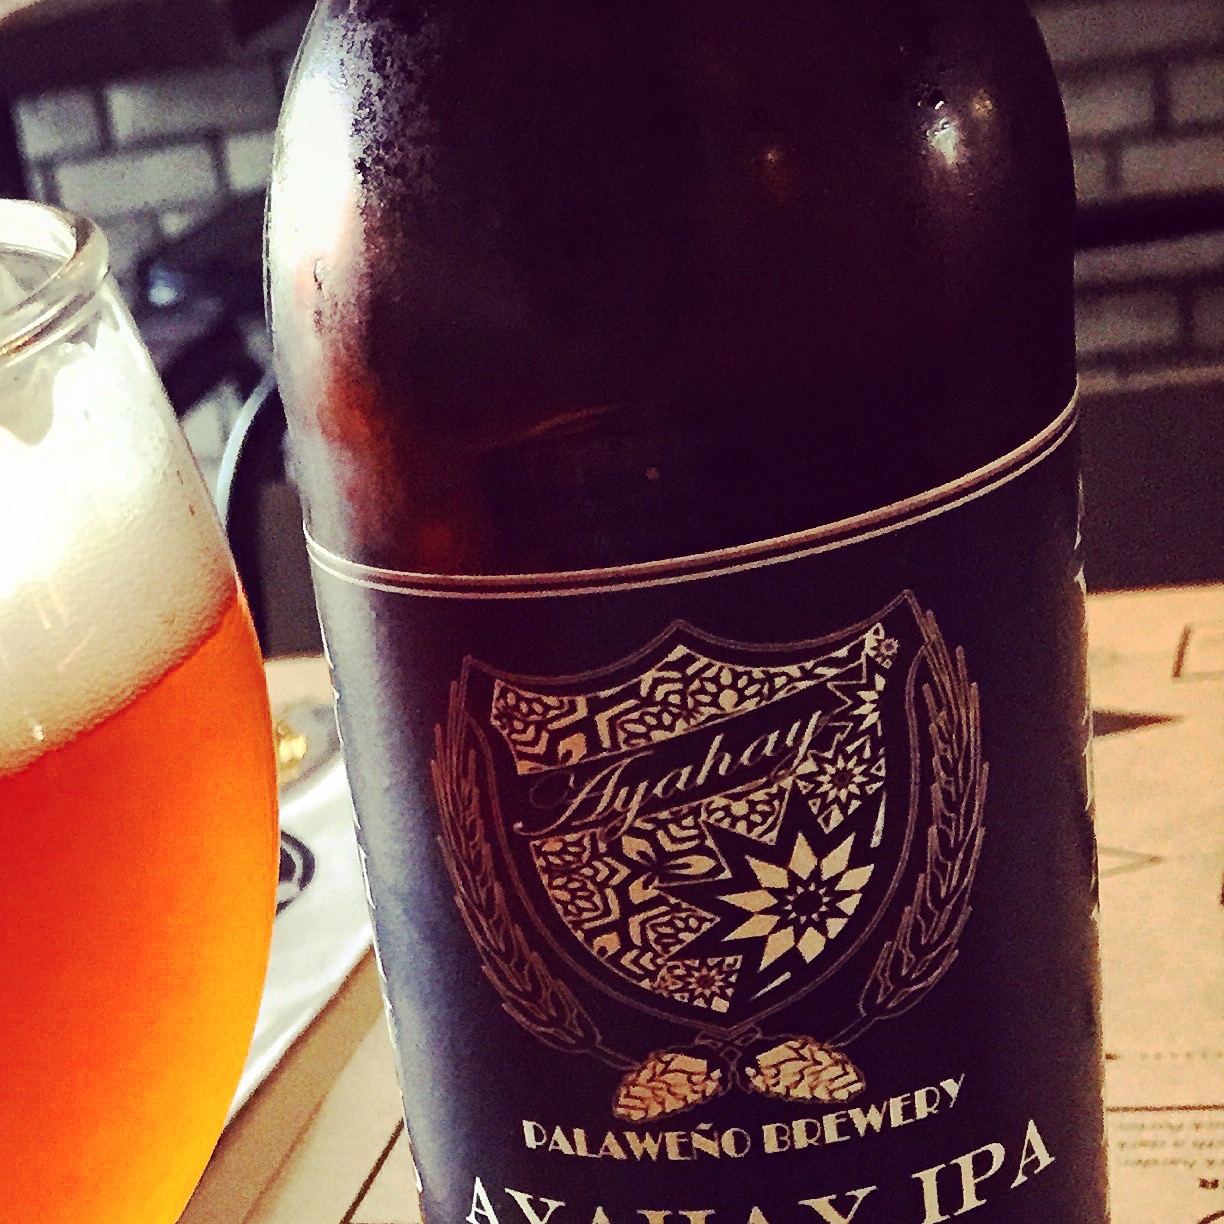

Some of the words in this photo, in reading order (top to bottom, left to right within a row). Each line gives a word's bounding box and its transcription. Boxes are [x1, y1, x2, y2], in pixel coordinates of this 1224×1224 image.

[513, 710, 823, 842] Ayahay
[522, 1120, 751, 1161] PALAWEÑO
[763, 1073, 965, 1154] BREWERY
